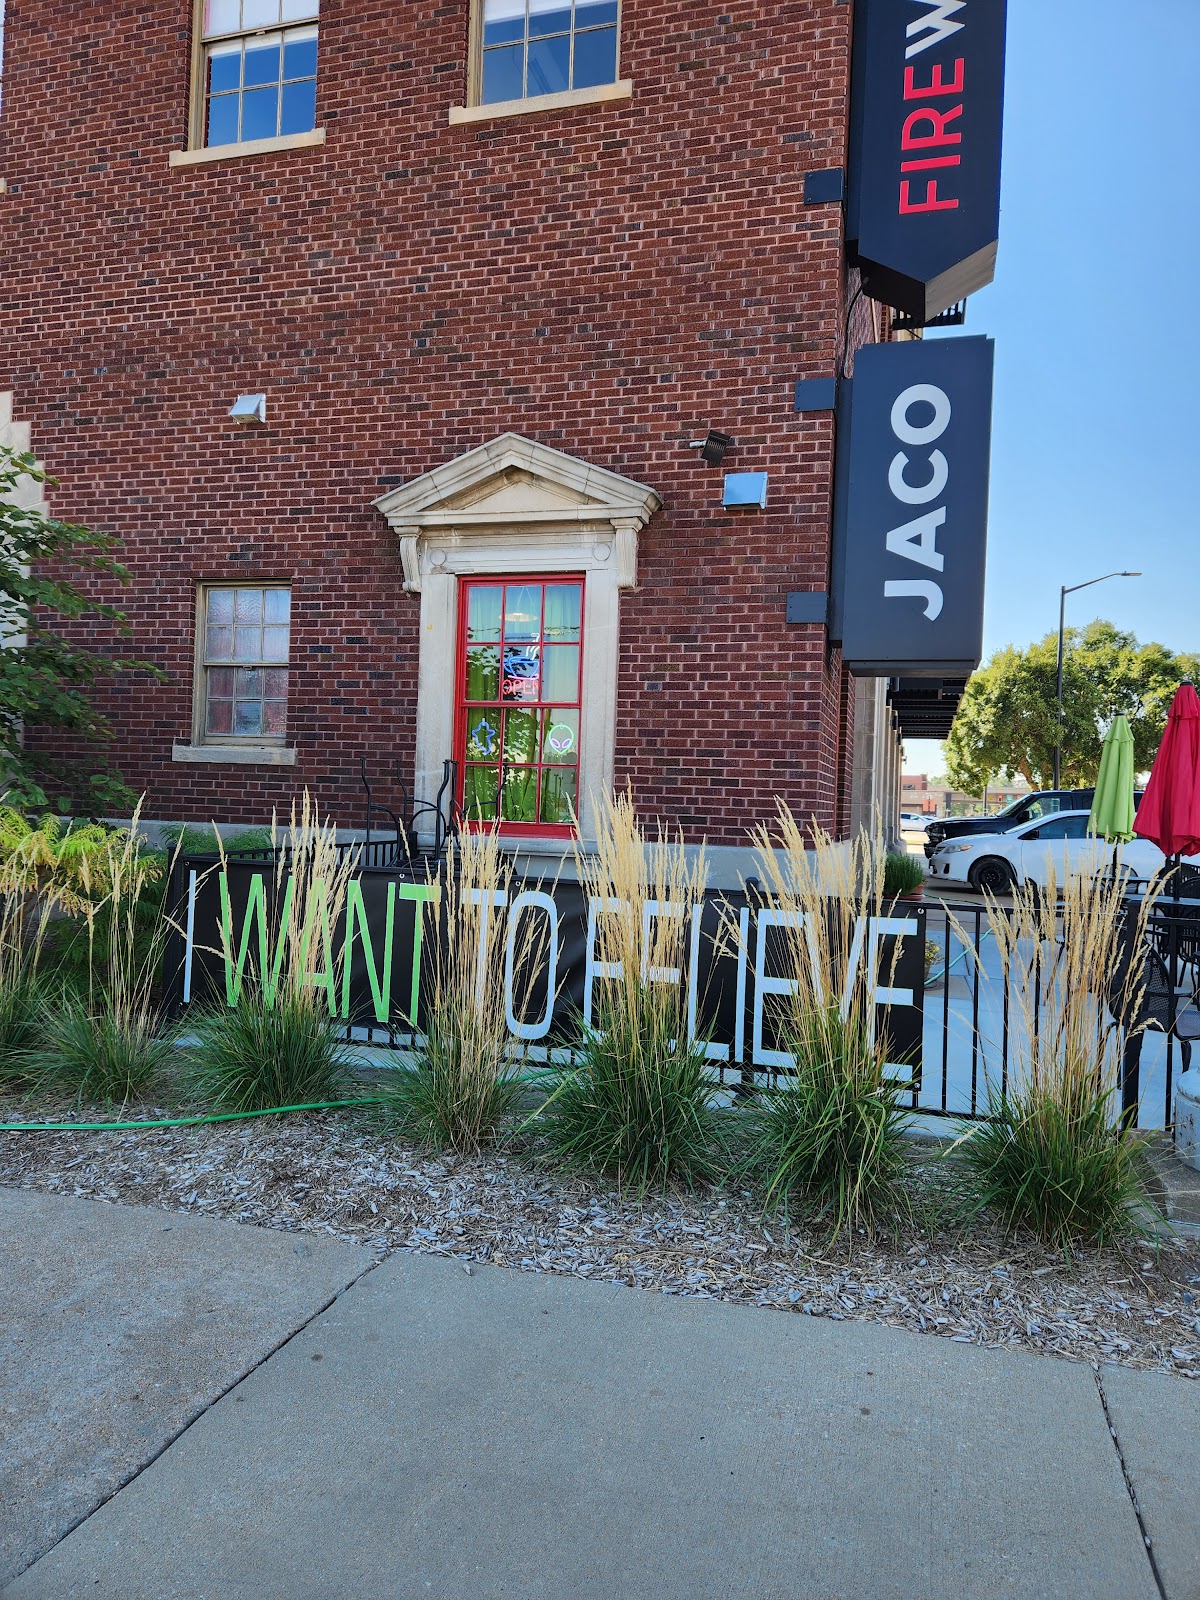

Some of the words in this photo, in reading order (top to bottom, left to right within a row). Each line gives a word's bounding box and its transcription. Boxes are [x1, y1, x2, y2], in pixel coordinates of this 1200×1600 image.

[884, 383, 952, 622] JACO
[502, 679, 540, 695] OPEN
[183, 869, 197, 1004] I
[219, 871, 442, 1027] WANT
[461, 887, 559, 1041] TO
